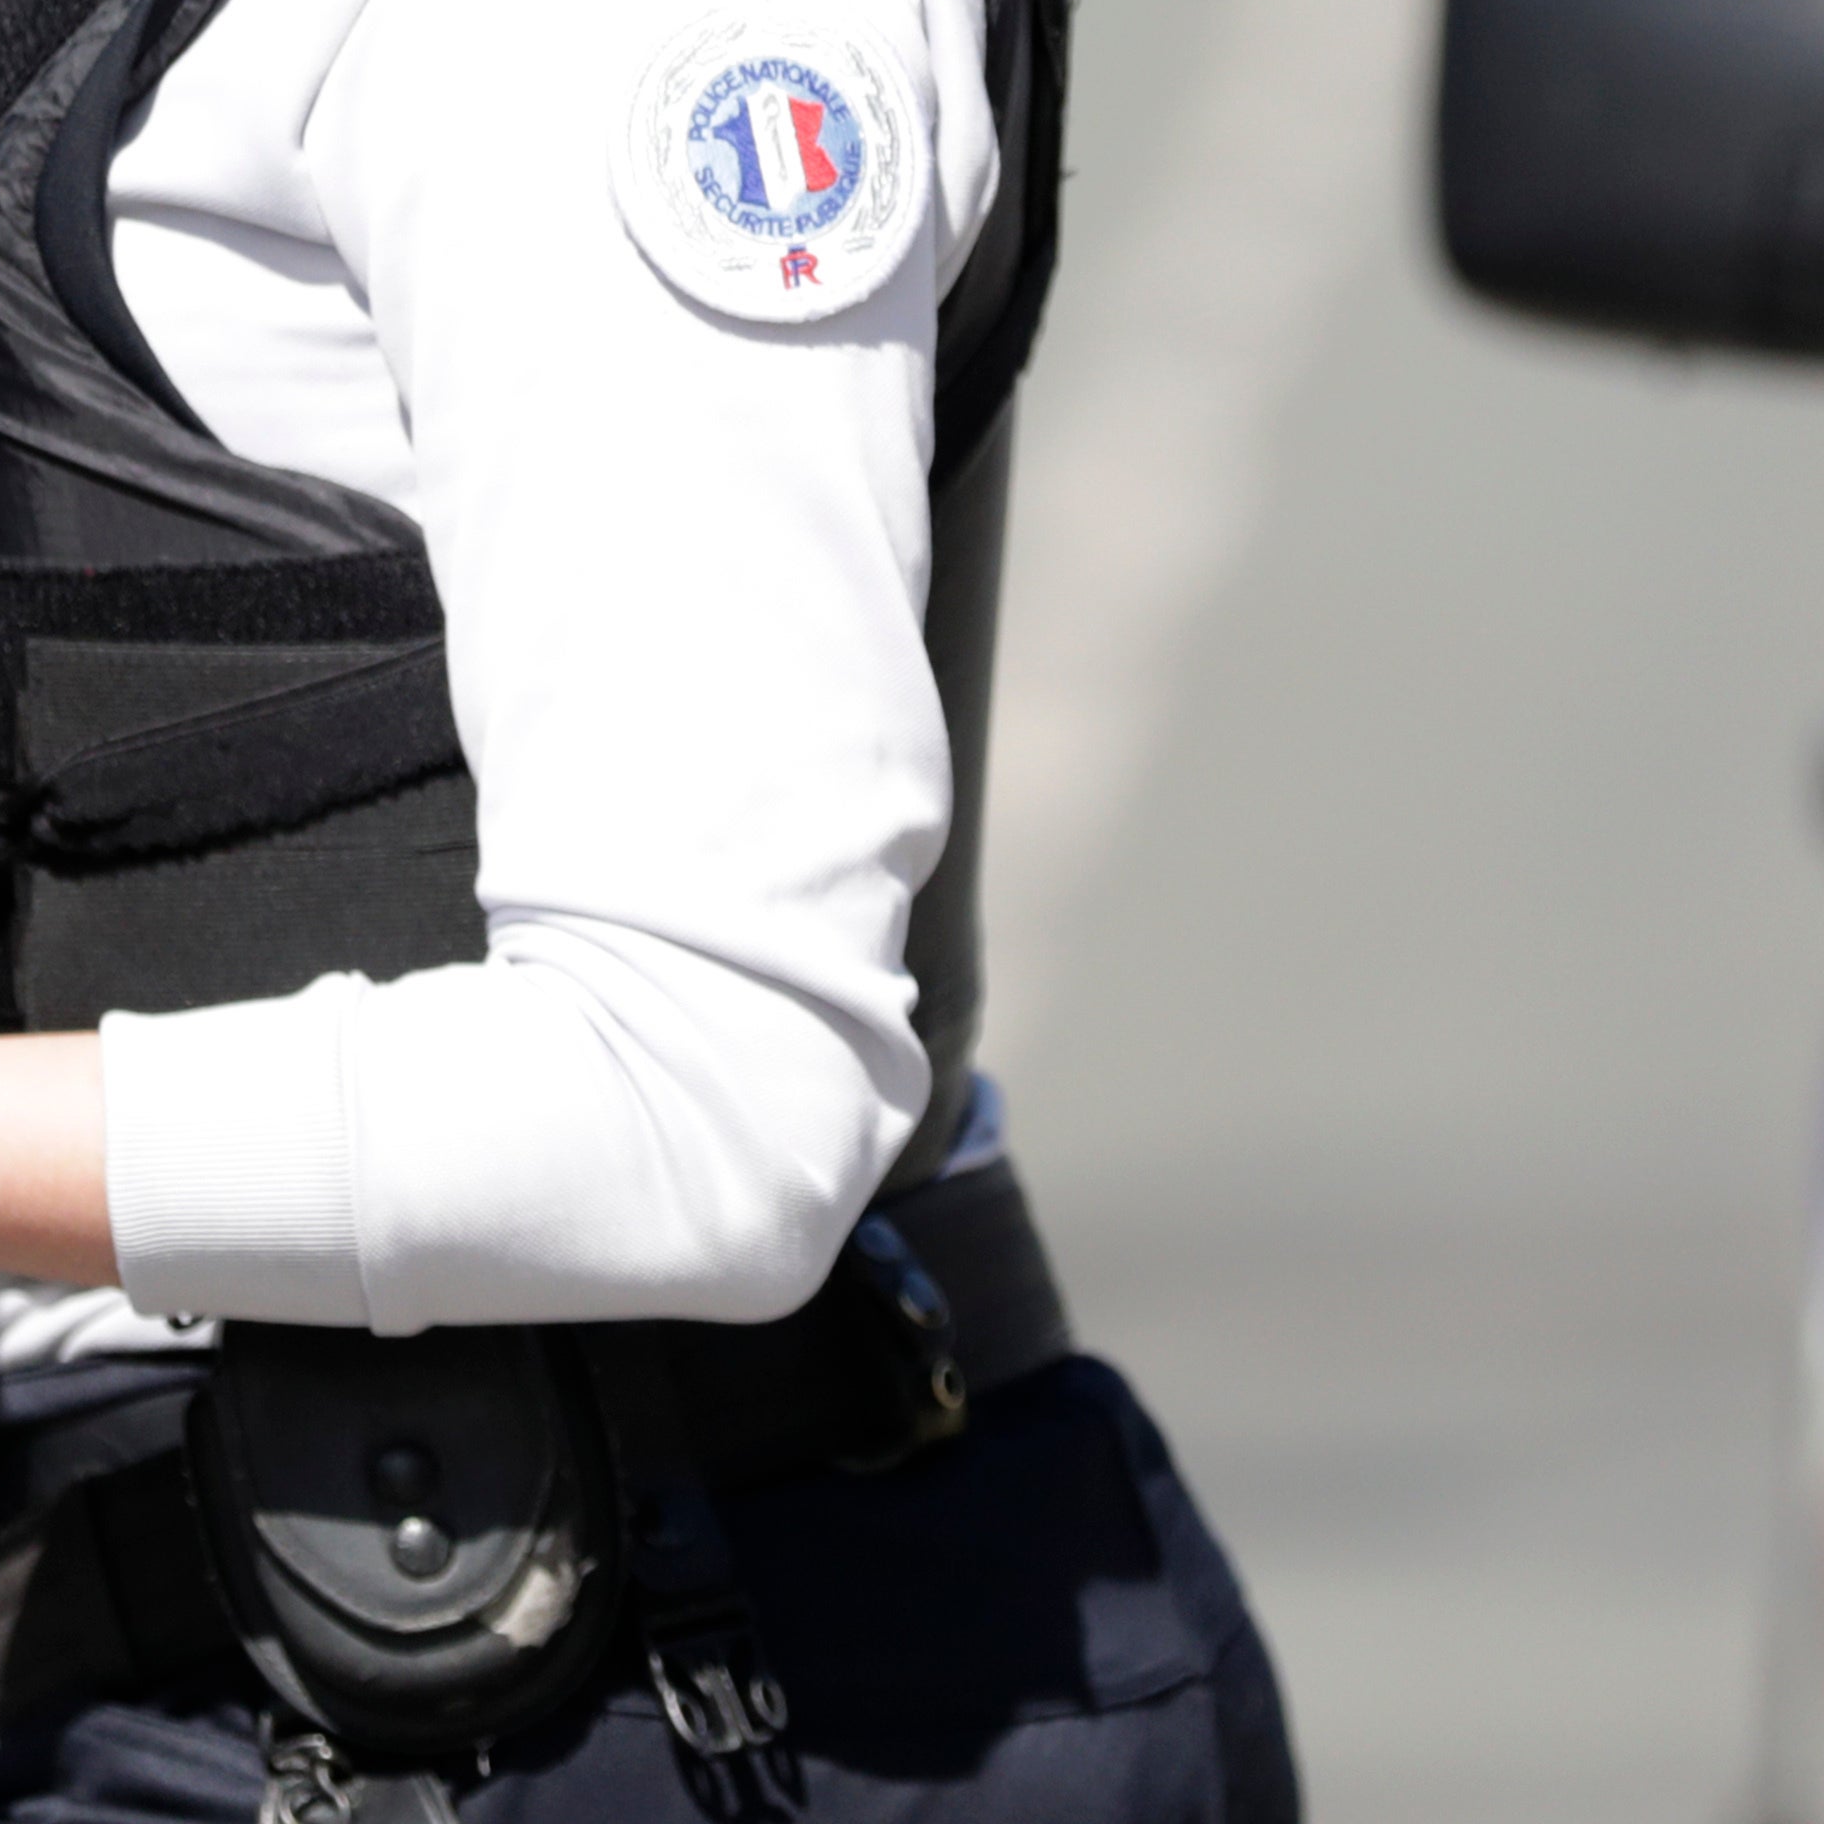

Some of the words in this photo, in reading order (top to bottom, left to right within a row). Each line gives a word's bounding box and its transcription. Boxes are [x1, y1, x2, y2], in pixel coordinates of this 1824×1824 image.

[688, 71, 742, 141] POLICE
[739, 60, 850, 122] NATIONALE
[694, 166, 793, 238] SECURITE
[794, 140, 862, 235] PUBLIQUE
